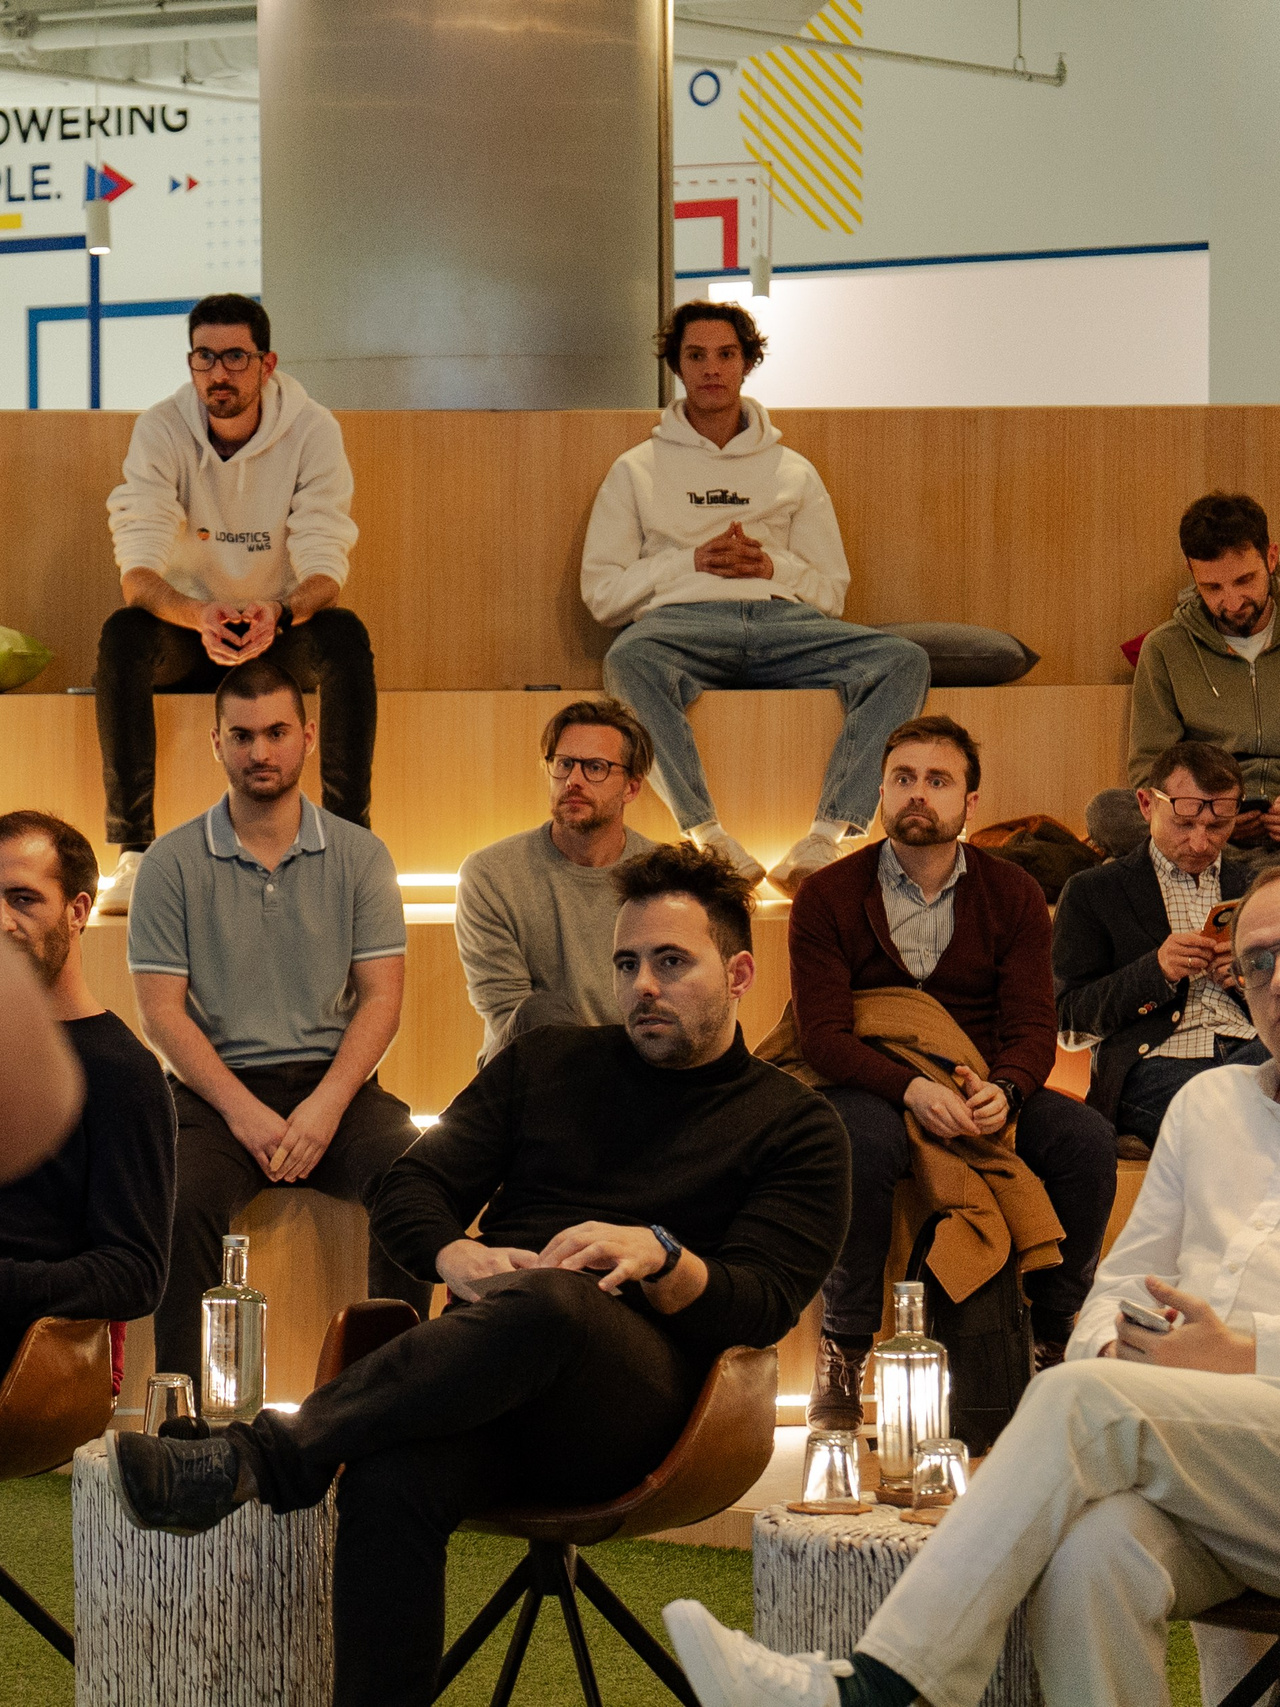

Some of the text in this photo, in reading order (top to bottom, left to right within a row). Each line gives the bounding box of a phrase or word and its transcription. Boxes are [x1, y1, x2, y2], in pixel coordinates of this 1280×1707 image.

[687, 492, 705, 505] The
[215, 531, 271, 543] LOGISTICS
[247, 542, 271, 552] WMS
